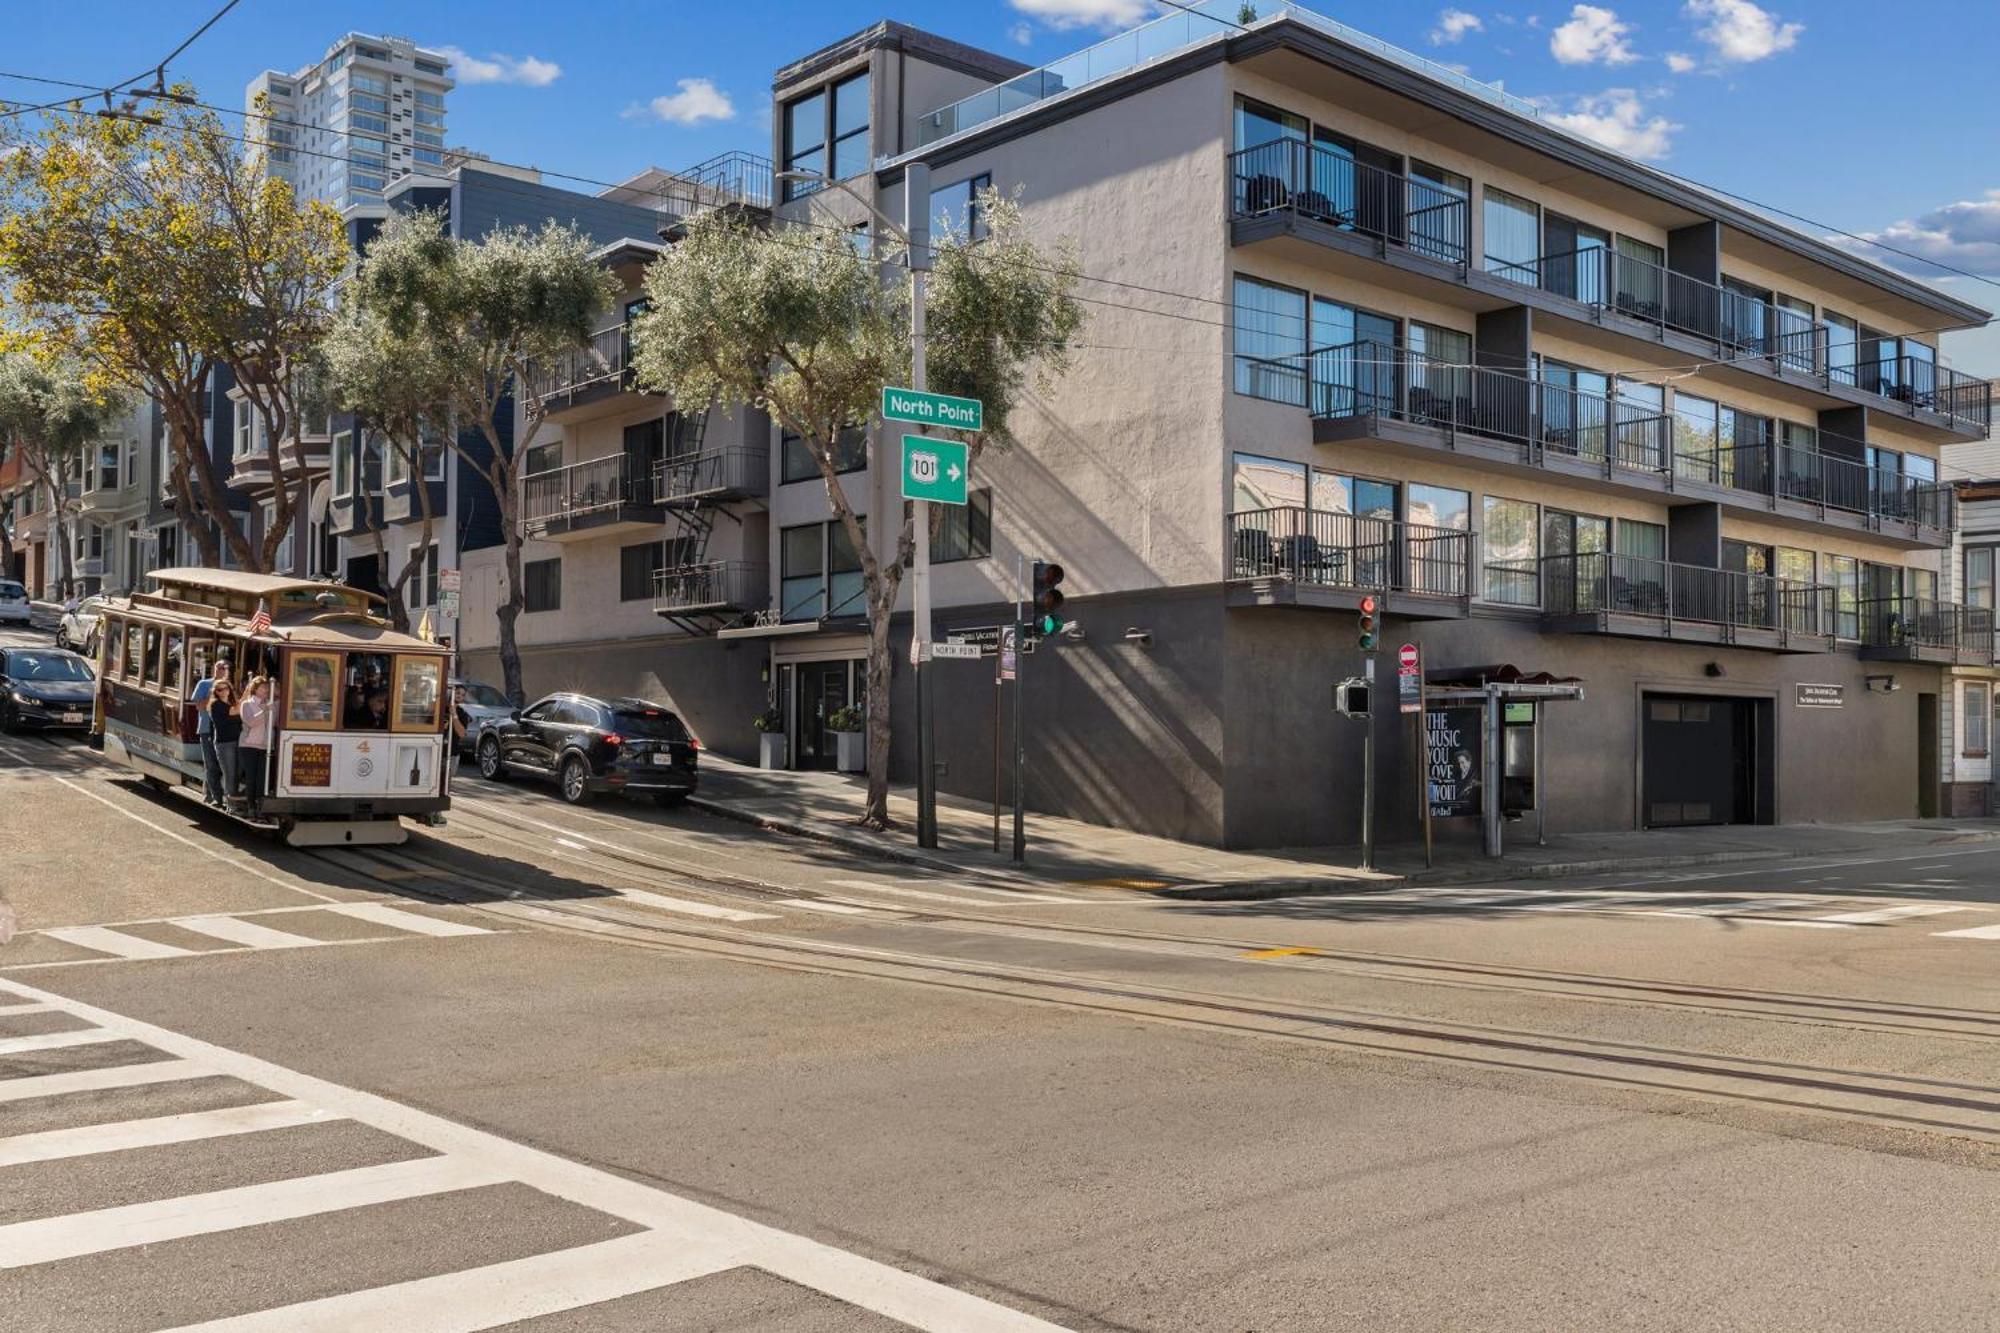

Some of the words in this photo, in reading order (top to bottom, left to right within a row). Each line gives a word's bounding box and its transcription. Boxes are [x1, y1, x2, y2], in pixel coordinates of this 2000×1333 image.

[891, 395, 933, 417] North
[938, 402, 975, 423] Point
[915, 459, 934, 477] 101
[753, 609, 781, 628] 2655
[935, 645, 957, 655] NORTH
[959, 646, 977, 656] POINT
[1425, 712, 1448, 730] THE
[356, 740, 370, 753] 4
[1426, 729, 1461, 747] MUSIC
[1427, 747, 1449, 765] YOU
